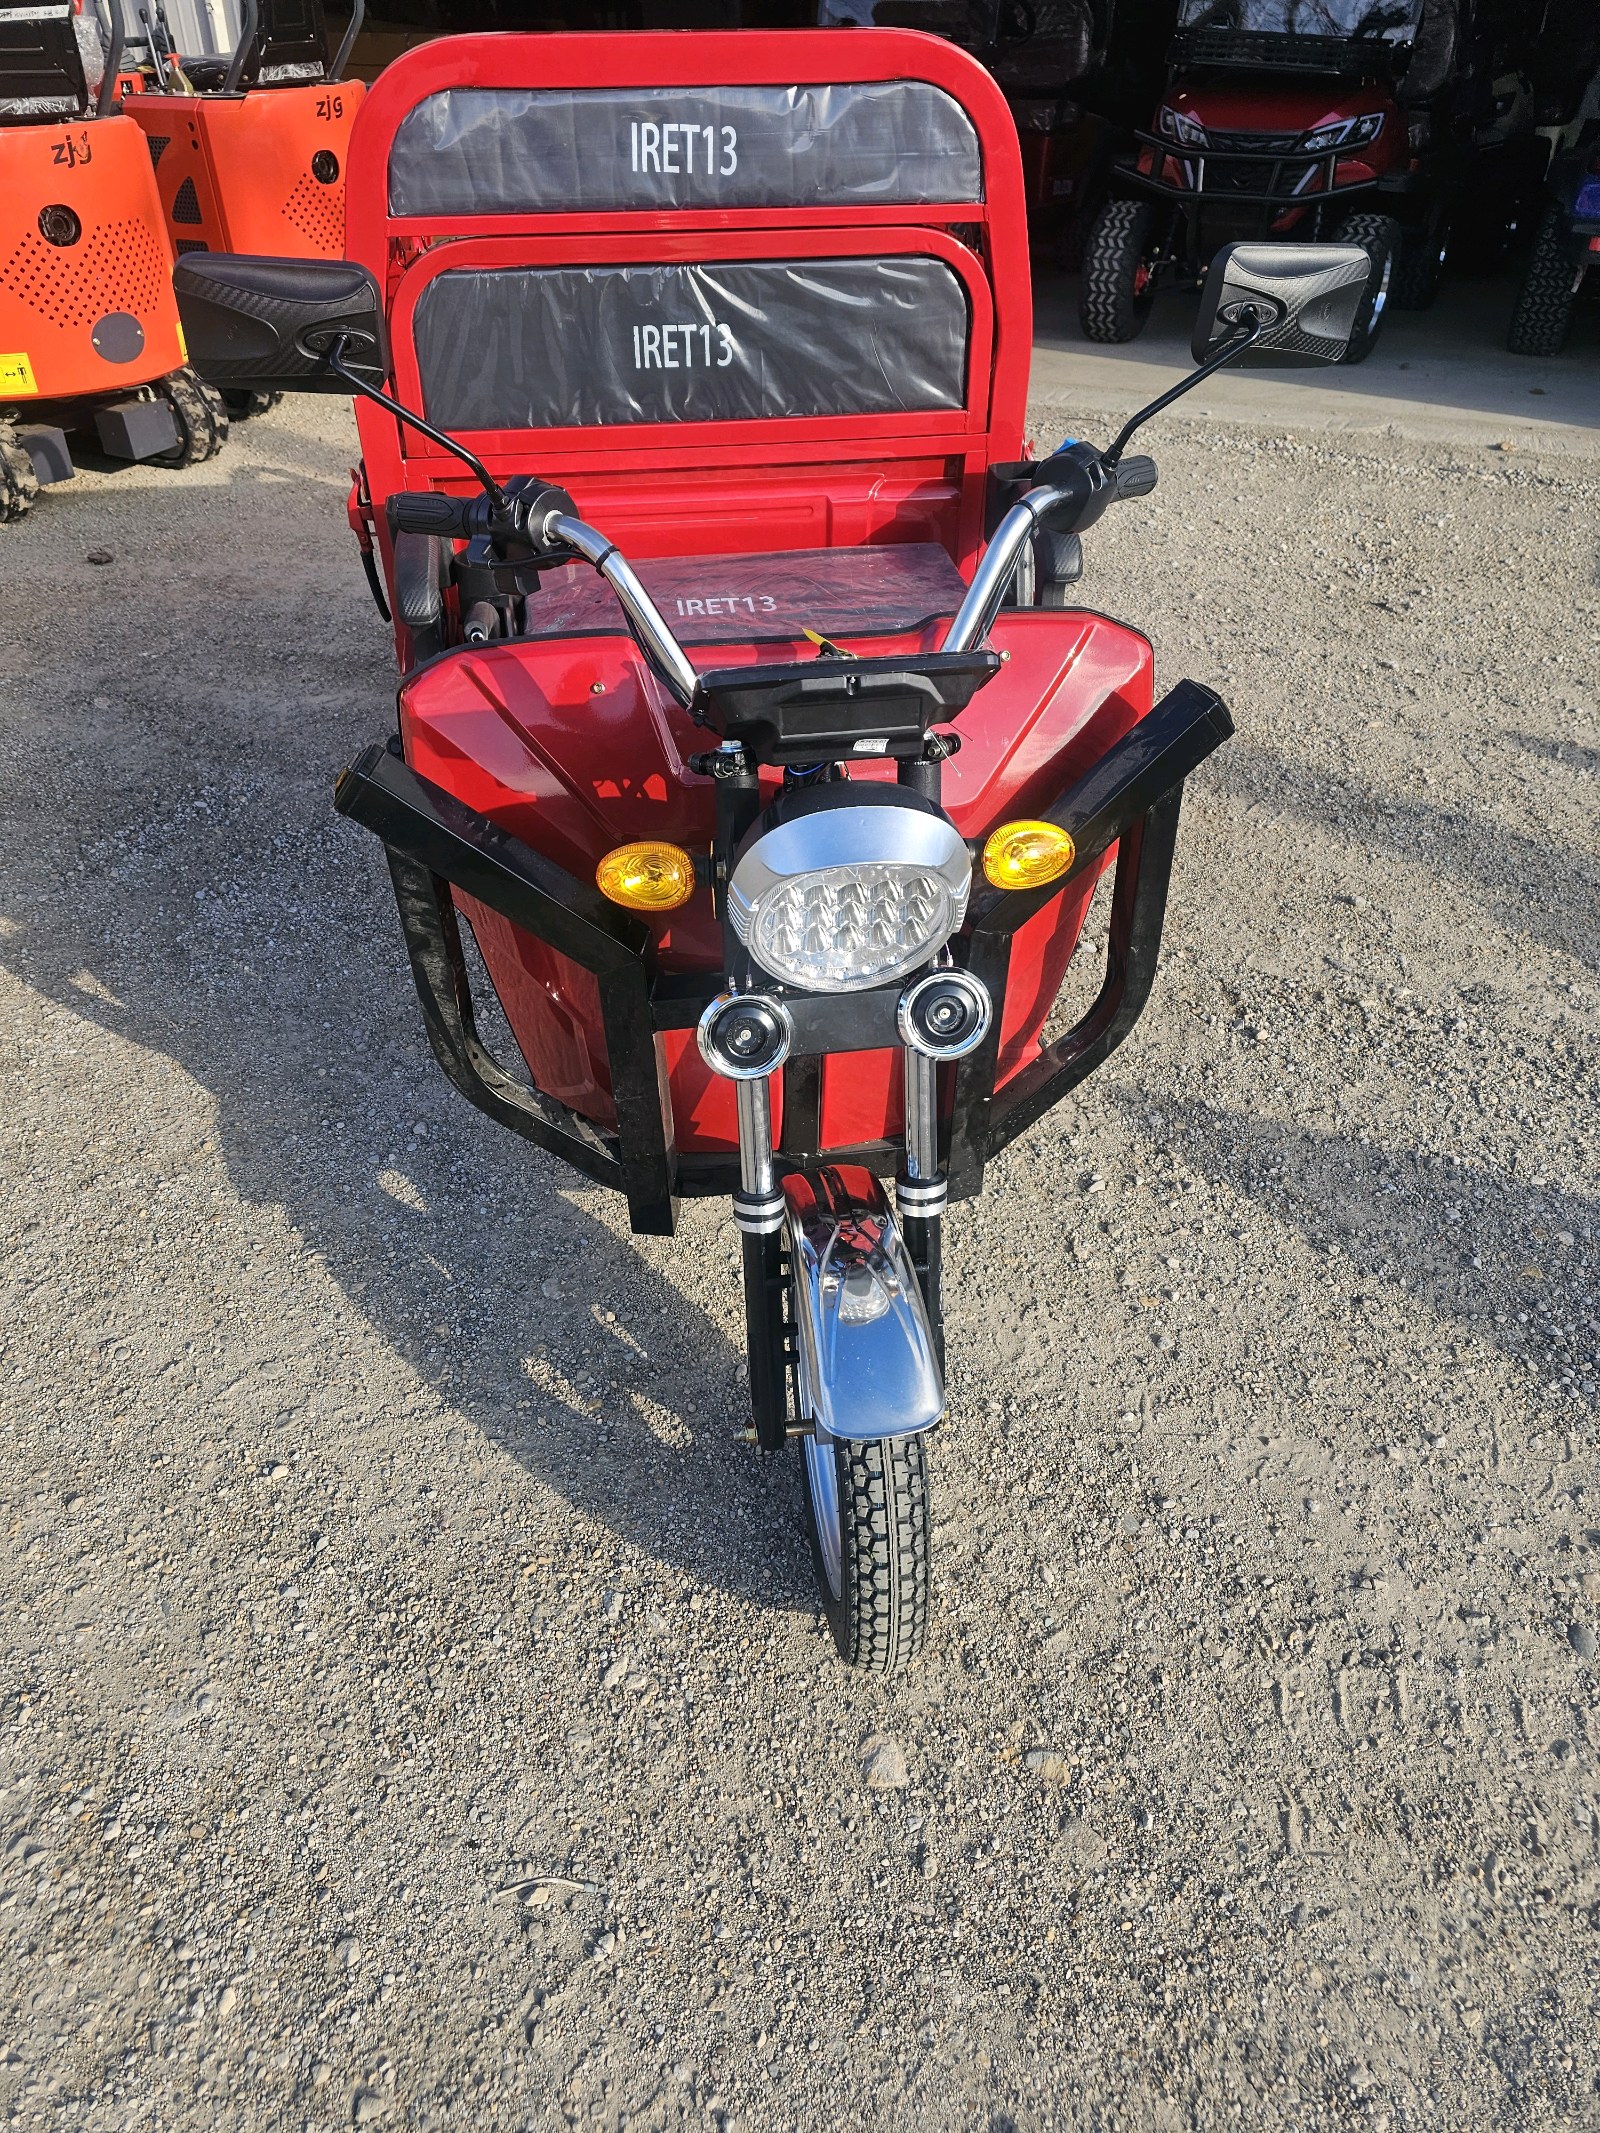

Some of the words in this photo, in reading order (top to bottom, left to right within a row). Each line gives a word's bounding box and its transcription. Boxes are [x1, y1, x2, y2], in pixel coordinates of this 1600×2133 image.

[316, 94, 343, 121] zjg
[631, 122, 738, 176] IRET13
[633, 323, 733, 369] IRET13
[676, 595, 777, 616] IRET13
